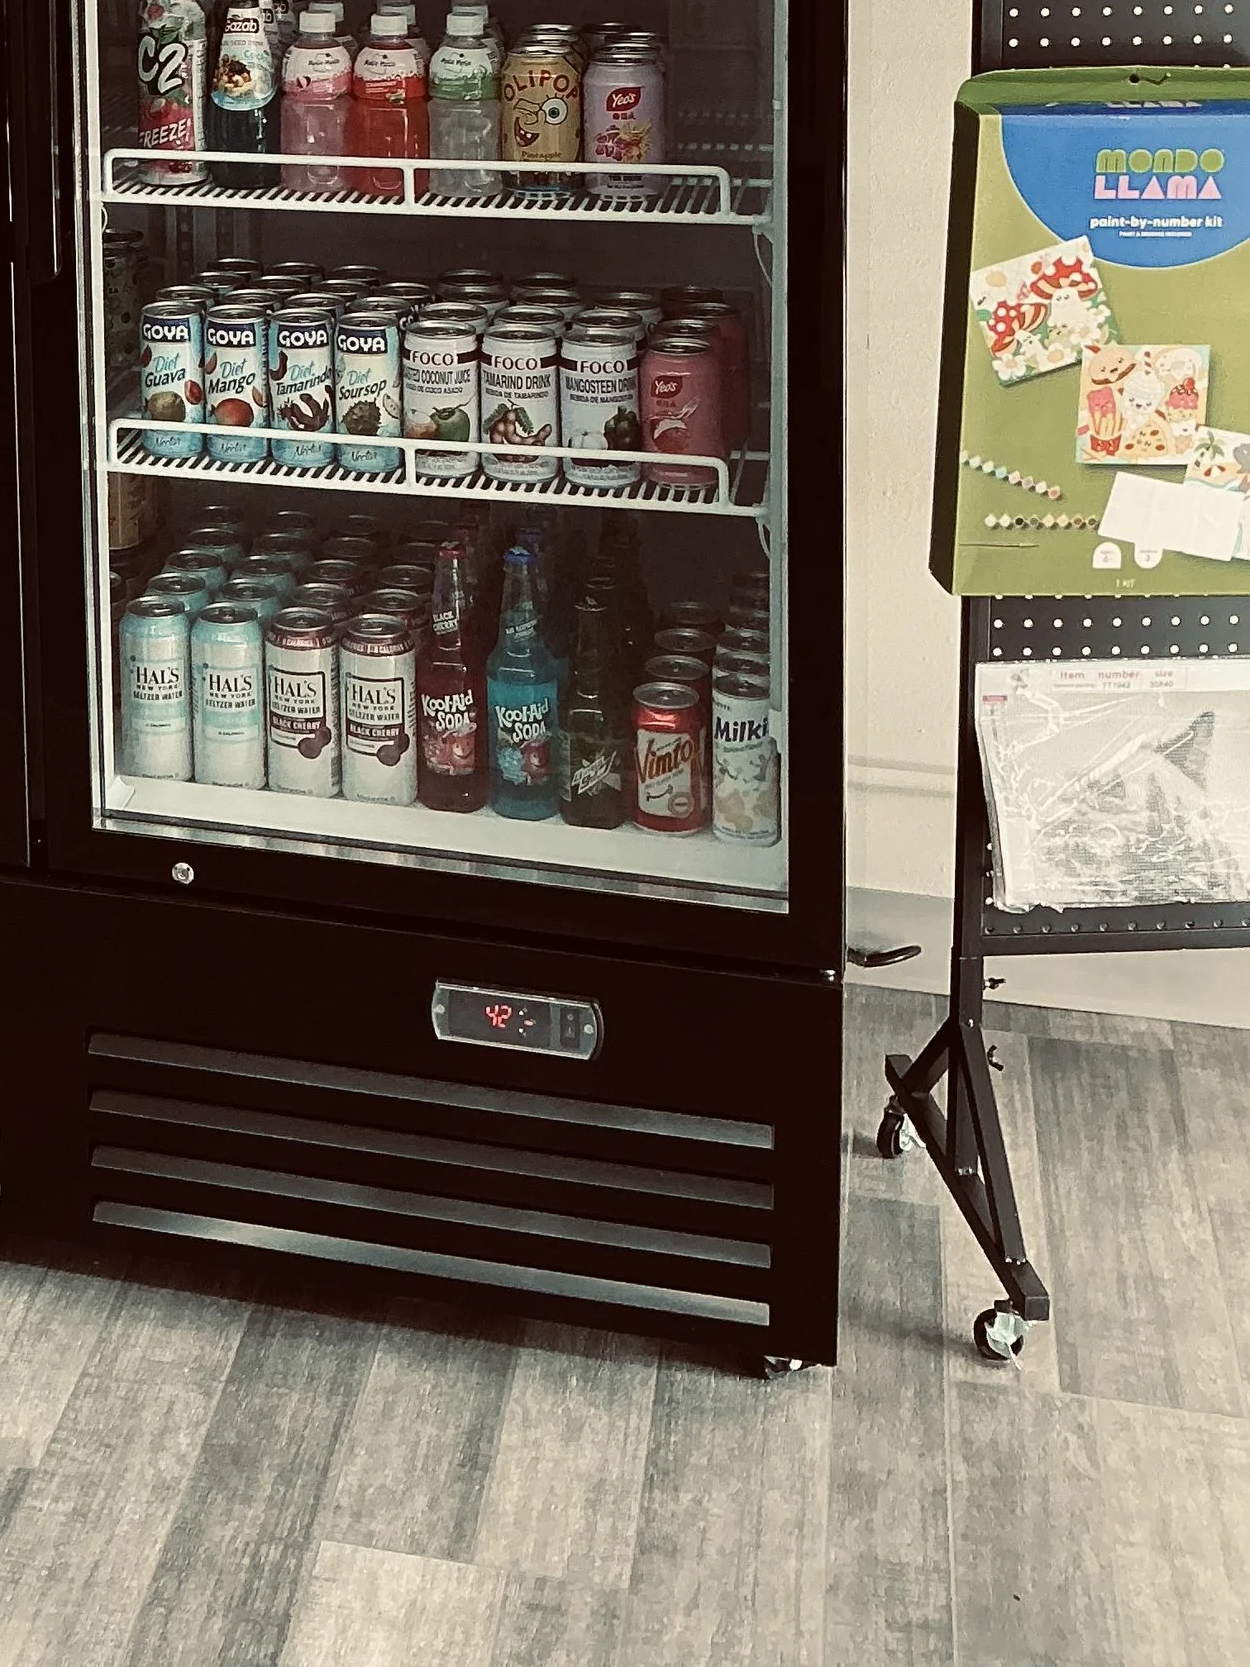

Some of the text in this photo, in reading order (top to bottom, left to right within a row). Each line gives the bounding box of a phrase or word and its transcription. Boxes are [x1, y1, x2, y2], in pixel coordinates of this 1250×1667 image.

[137, 34, 188, 95] C2
[503, 69, 580, 101] OLIPOP
[612, 92, 638, 108] Yeo's
[1095, 147, 1225, 173] MONDO
[1093, 174, 1222, 200] LLAMA
[1089, 215, 1223, 230] paint-by-number kit
[143, 324, 190, 340] GOYA
[207, 328, 255, 345] GOYA
[279, 328, 328, 345] GOYA
[338, 335, 386, 352] GOYA
[153, 352, 180, 374] Diet
[220, 358, 248, 380] Diet
[412, 352, 454, 366] FOCO
[492, 356, 537, 371] FOCO
[580, 360, 624, 374] FOCO
[145, 367, 186, 388] Guava
[288, 360, 315, 382] Diet
[348, 367, 371, 386] Diet
[421, 368, 453, 384] COCONUT
[454, 368, 472, 384] JUICE
[482, 370, 552, 390] TAMARIND DRINK
[208, 374, 256, 395] Mango
[339, 379, 387, 401] Soursop
[565, 375, 618, 394] MANGOSTEEN
[654, 378, 679, 395] Yeo's
[432, 610, 455, 623] BLACK
[432, 618, 459, 632] CHERRY
[136, 665, 180, 685] HAL'S
[209, 673, 253, 693] HAL'S
[1060, 669, 1173, 680] Item number size
[133, 690, 183, 701] SELTZER WATER
[274, 675, 317, 698] HAL'S
[352, 683, 397, 705] HAL'S
[205, 698, 256, 709] SELTZER WATER
[421, 688, 474, 717] Kool-Aid
[494, 697, 550, 728] Kool-Aid
[272, 715, 322, 731] BLACK CHERRY
[350, 723, 400, 738] BLACK CHERRY
[434, 712, 471, 733] SODA
[511, 720, 547, 743] SODA
[634, 737, 694, 784] Vimto
[485, 1004, 513, 1028] 42
